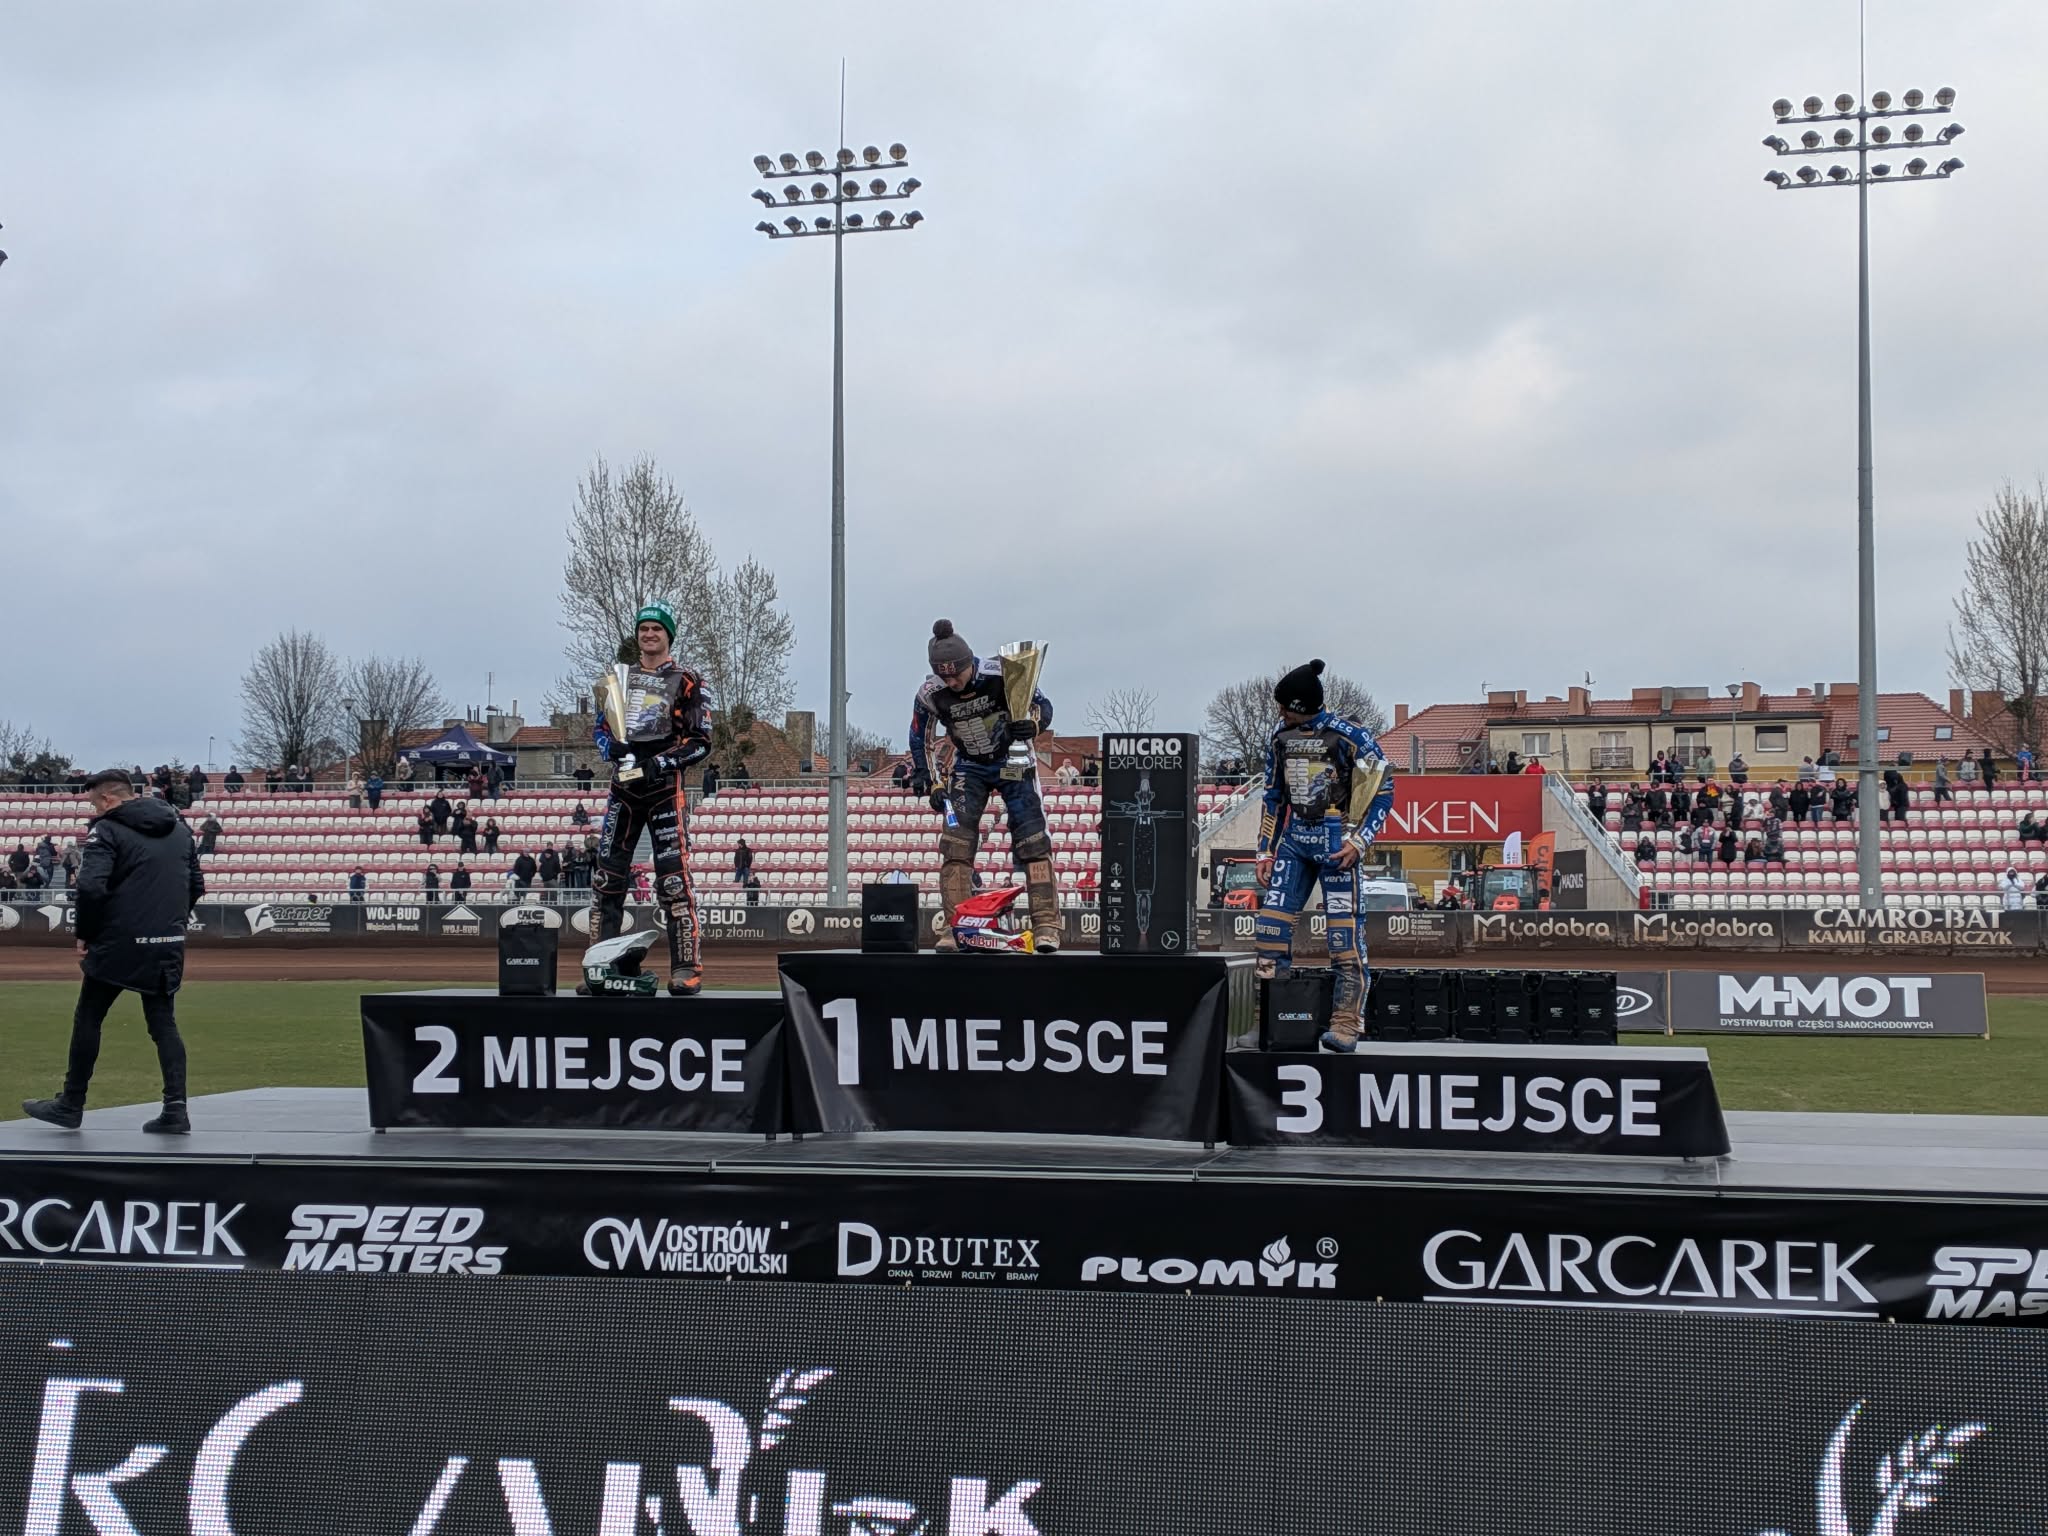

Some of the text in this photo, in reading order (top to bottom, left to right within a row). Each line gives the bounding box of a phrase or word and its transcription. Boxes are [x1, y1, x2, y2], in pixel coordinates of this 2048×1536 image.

[1109, 738, 1182, 756] MICRO
[1285, 738, 1324, 748] SPEED
[1285, 746, 1329, 754] MASTERS
[1108, 756, 1183, 770] EXPLORER
[1382, 800, 1499, 834] NKEN
[254, 905, 333, 927] Farmer
[366, 906, 420, 921] WOJ-BUD
[710, 908, 746, 925] BUD
[1813, 907, 2002, 930] CAMRO-BAT
[726, 926, 765, 938] złomu
[977, 936, 999, 949] Bull
[1808, 929, 2013, 945] KAMIL GRABARCZYK
[1720, 1018, 1934, 1031] DYSTRYBUTOR CZĘŚCI SAMOCHODOWYCH
[822, 998, 1169, 1086] 1 MIEJSCE
[412, 1025, 747, 1094] 2 MIEJSCE
[1276, 1064, 1662, 1137] 3 MIEJSCE
[285, 1204, 485, 1244] SPEED
[666, 1220, 771, 1254] OSTRÓW
[281, 1243, 510, 1276] MASTERS
[888, 1236, 1041, 1268] DRUTEX
[659, 1252, 788, 1275] WIELKOPOLSKI
[1422, 1229, 1879, 1304] GARCAREK
[887, 1268, 1039, 1282] OKNA DRZWI ROLETY BRAMY
